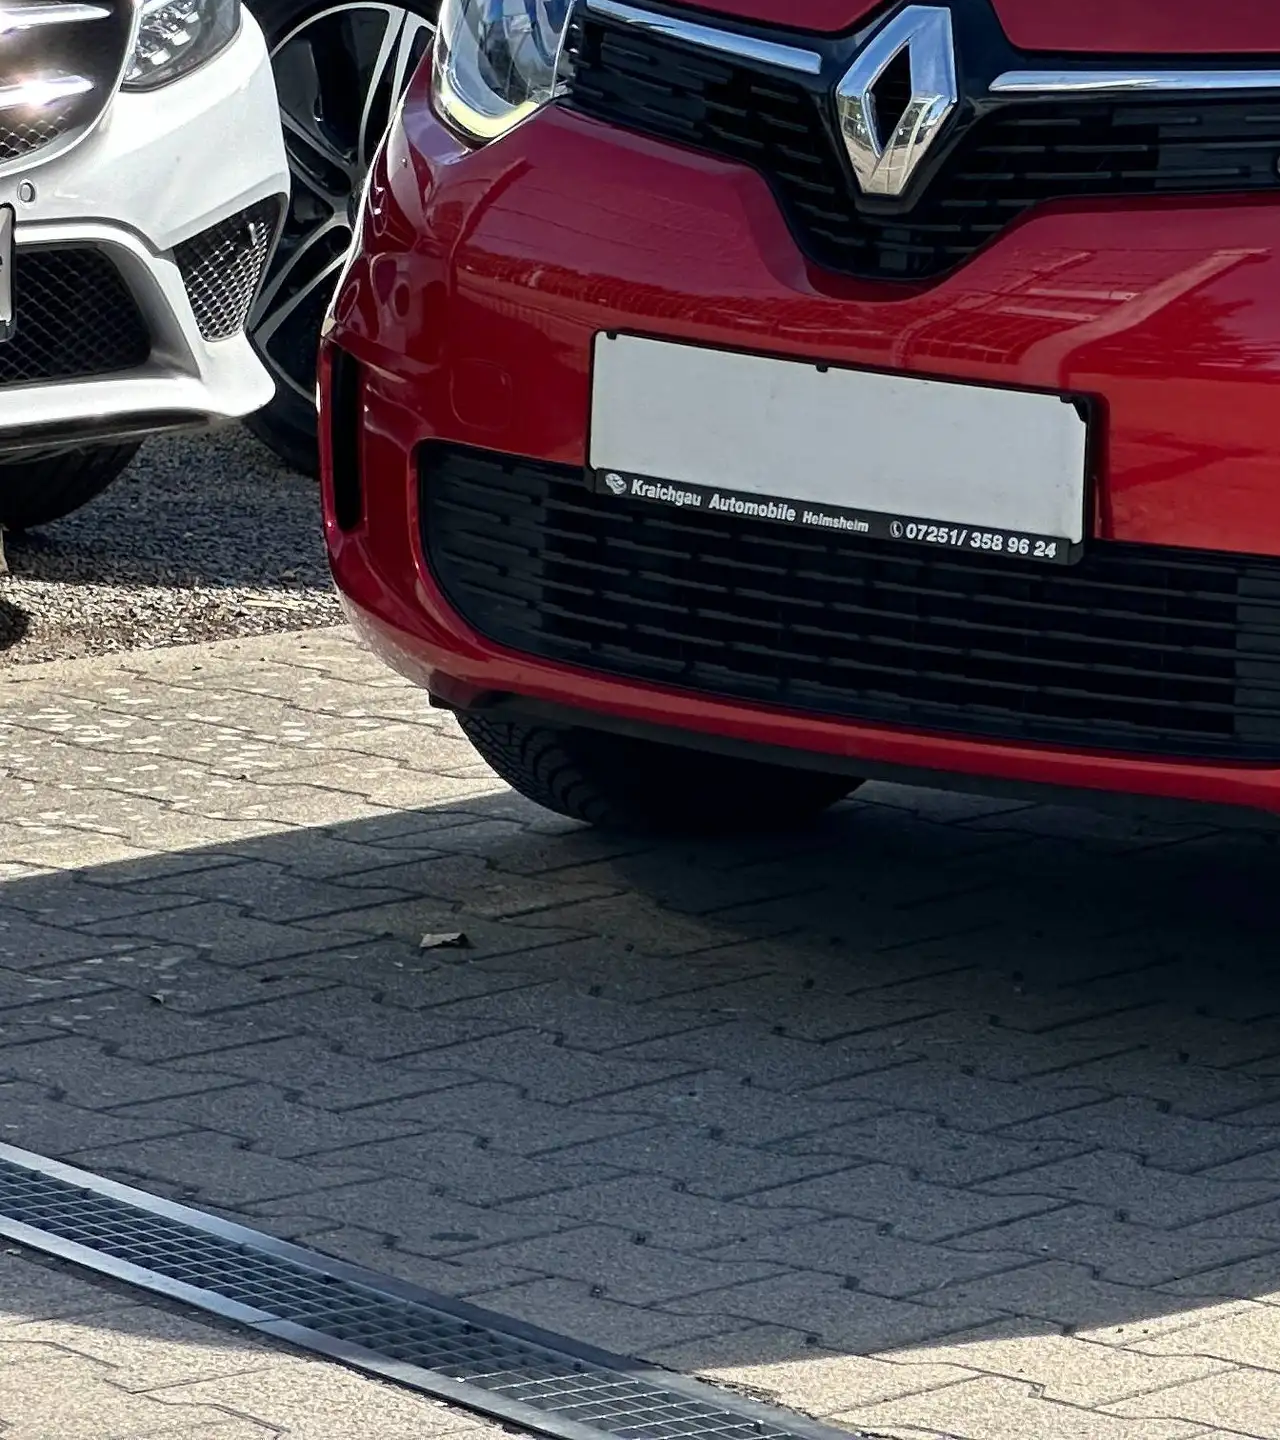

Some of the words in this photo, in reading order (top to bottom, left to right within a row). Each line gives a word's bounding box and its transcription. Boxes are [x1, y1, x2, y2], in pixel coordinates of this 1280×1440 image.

[631, 479, 702, 507] Kraichgau
[708, 493, 797, 522] Automobile
[802, 510, 869, 533] Helmsheim
[905, 523, 967, 546] 07251/
[969, 533, 1002, 551] 358
[1007, 536, 1030, 555] 96
[1033, 540, 1058, 558] 24
